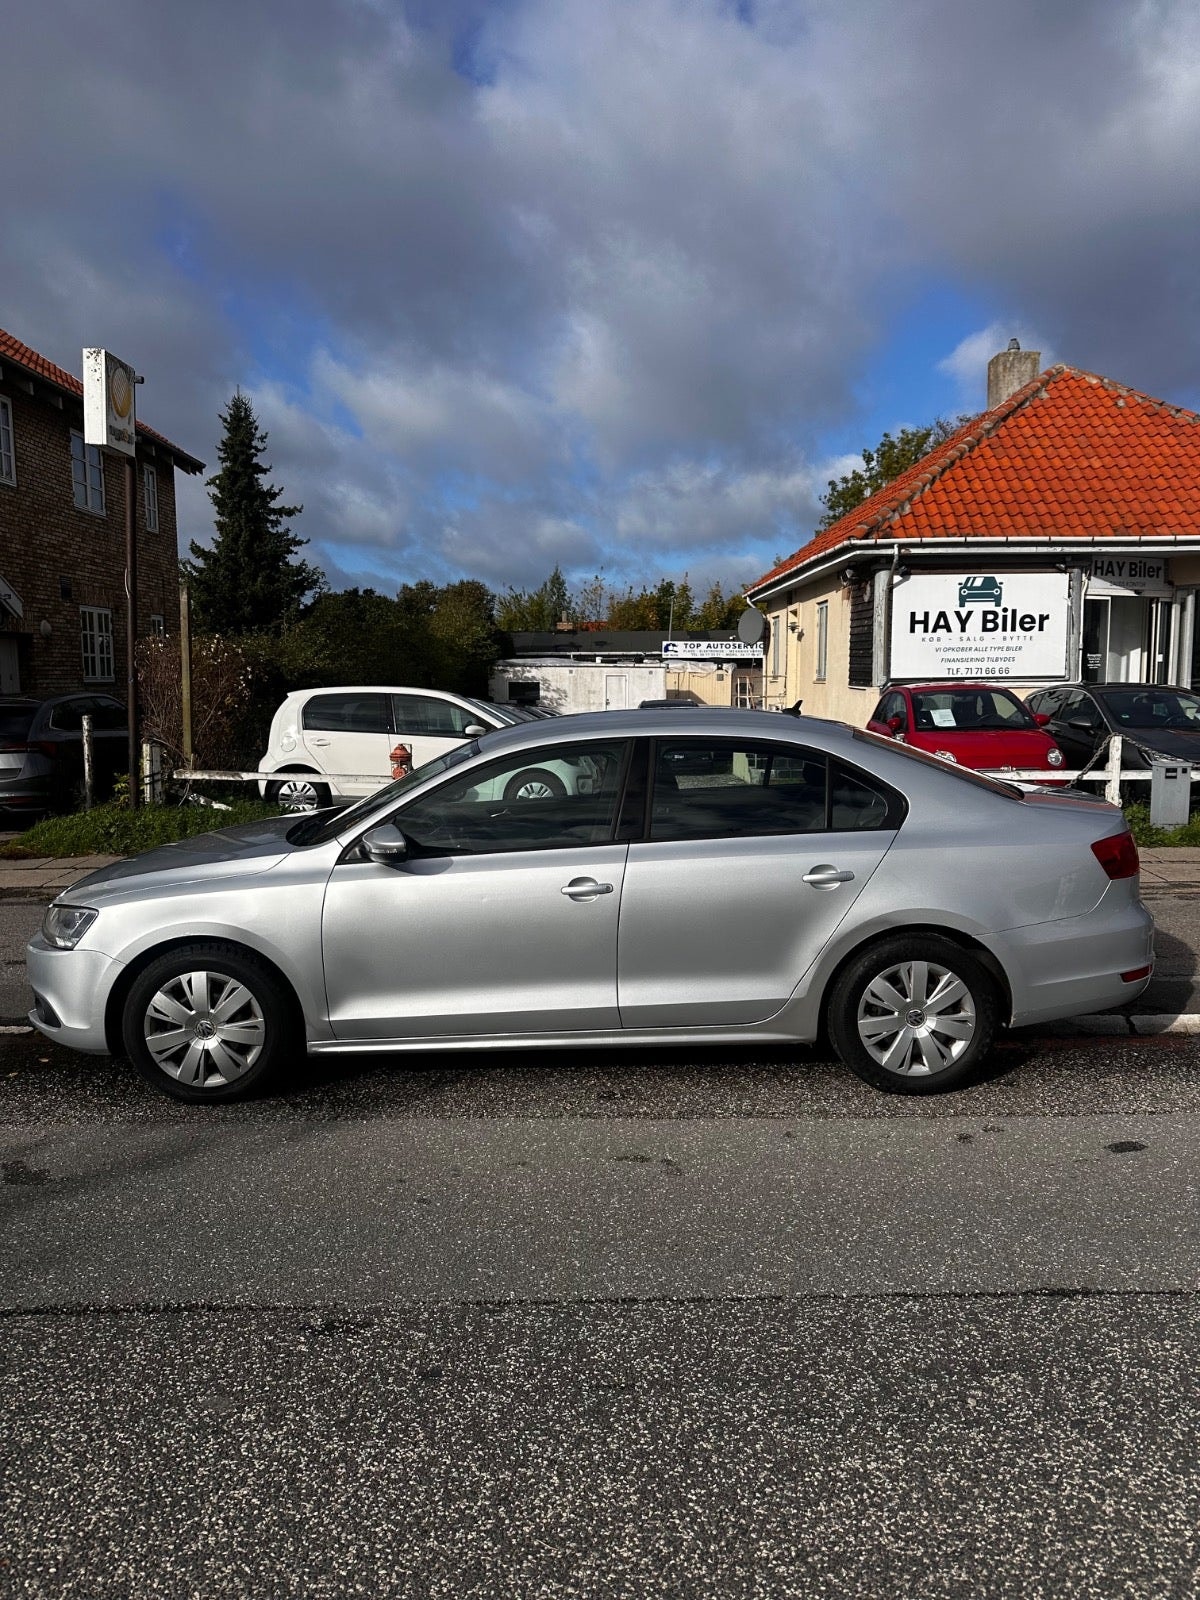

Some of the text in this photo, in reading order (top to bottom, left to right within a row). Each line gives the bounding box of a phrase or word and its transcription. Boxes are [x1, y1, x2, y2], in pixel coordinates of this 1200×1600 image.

[1094, 560, 1162, 578] HAY Biler
[909, 607, 1049, 633] HAY Biler
[947, 667, 1010, 675] TLF. 71 71 66 66
